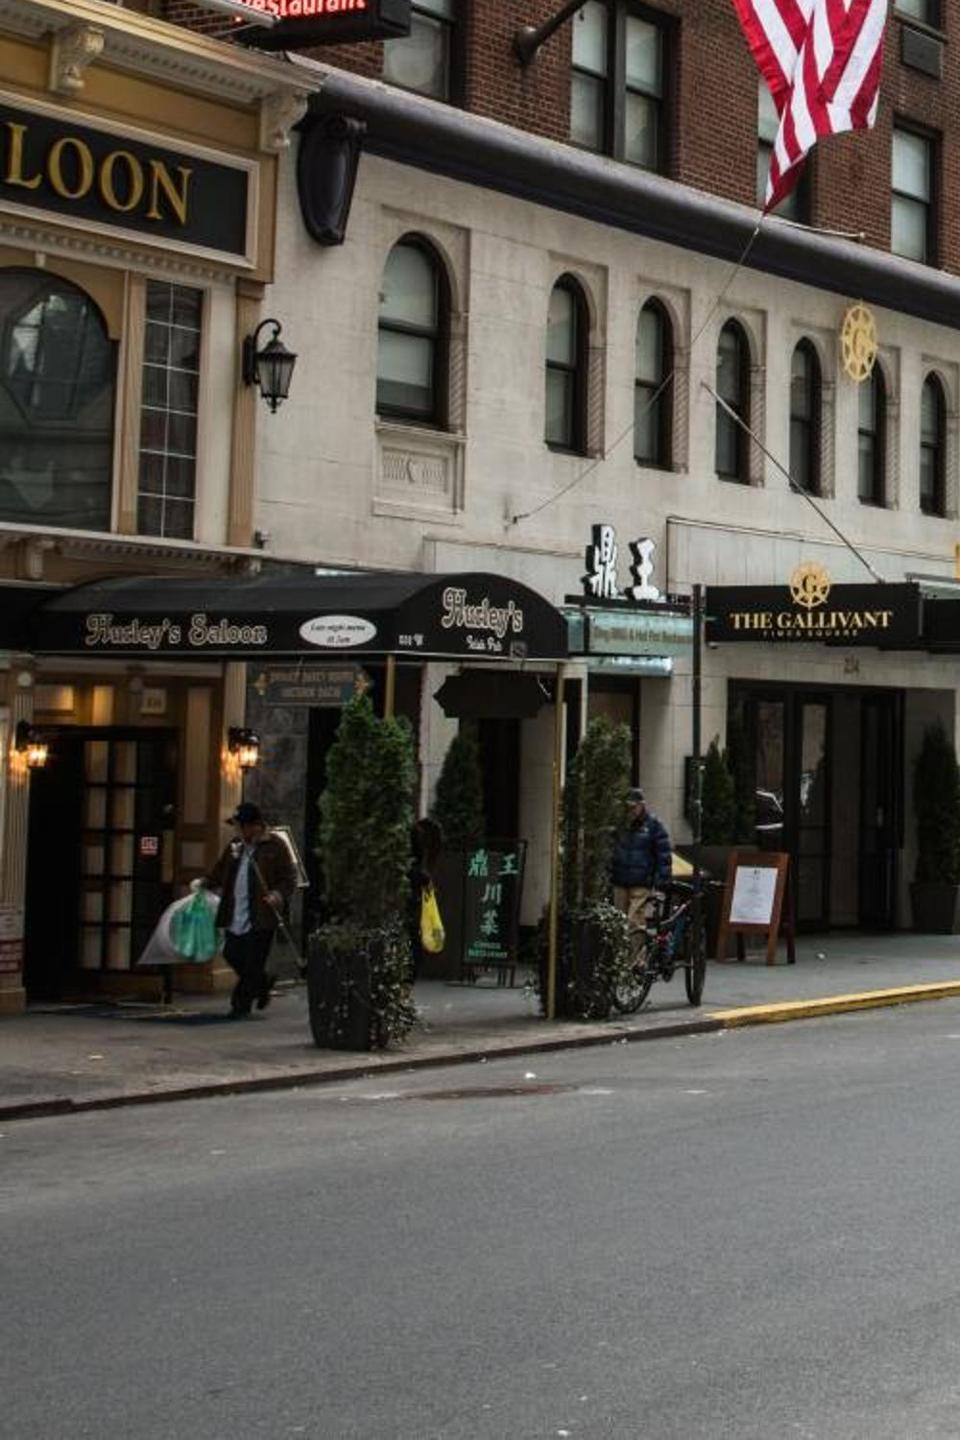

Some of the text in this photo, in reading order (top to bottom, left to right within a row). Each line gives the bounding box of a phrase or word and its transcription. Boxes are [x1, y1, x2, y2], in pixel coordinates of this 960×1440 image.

[441, 587, 523, 638] Hurley's
[730, 611, 892, 630] THE GALLIVANT
[85, 613, 268, 649] Hurley's Saloon
